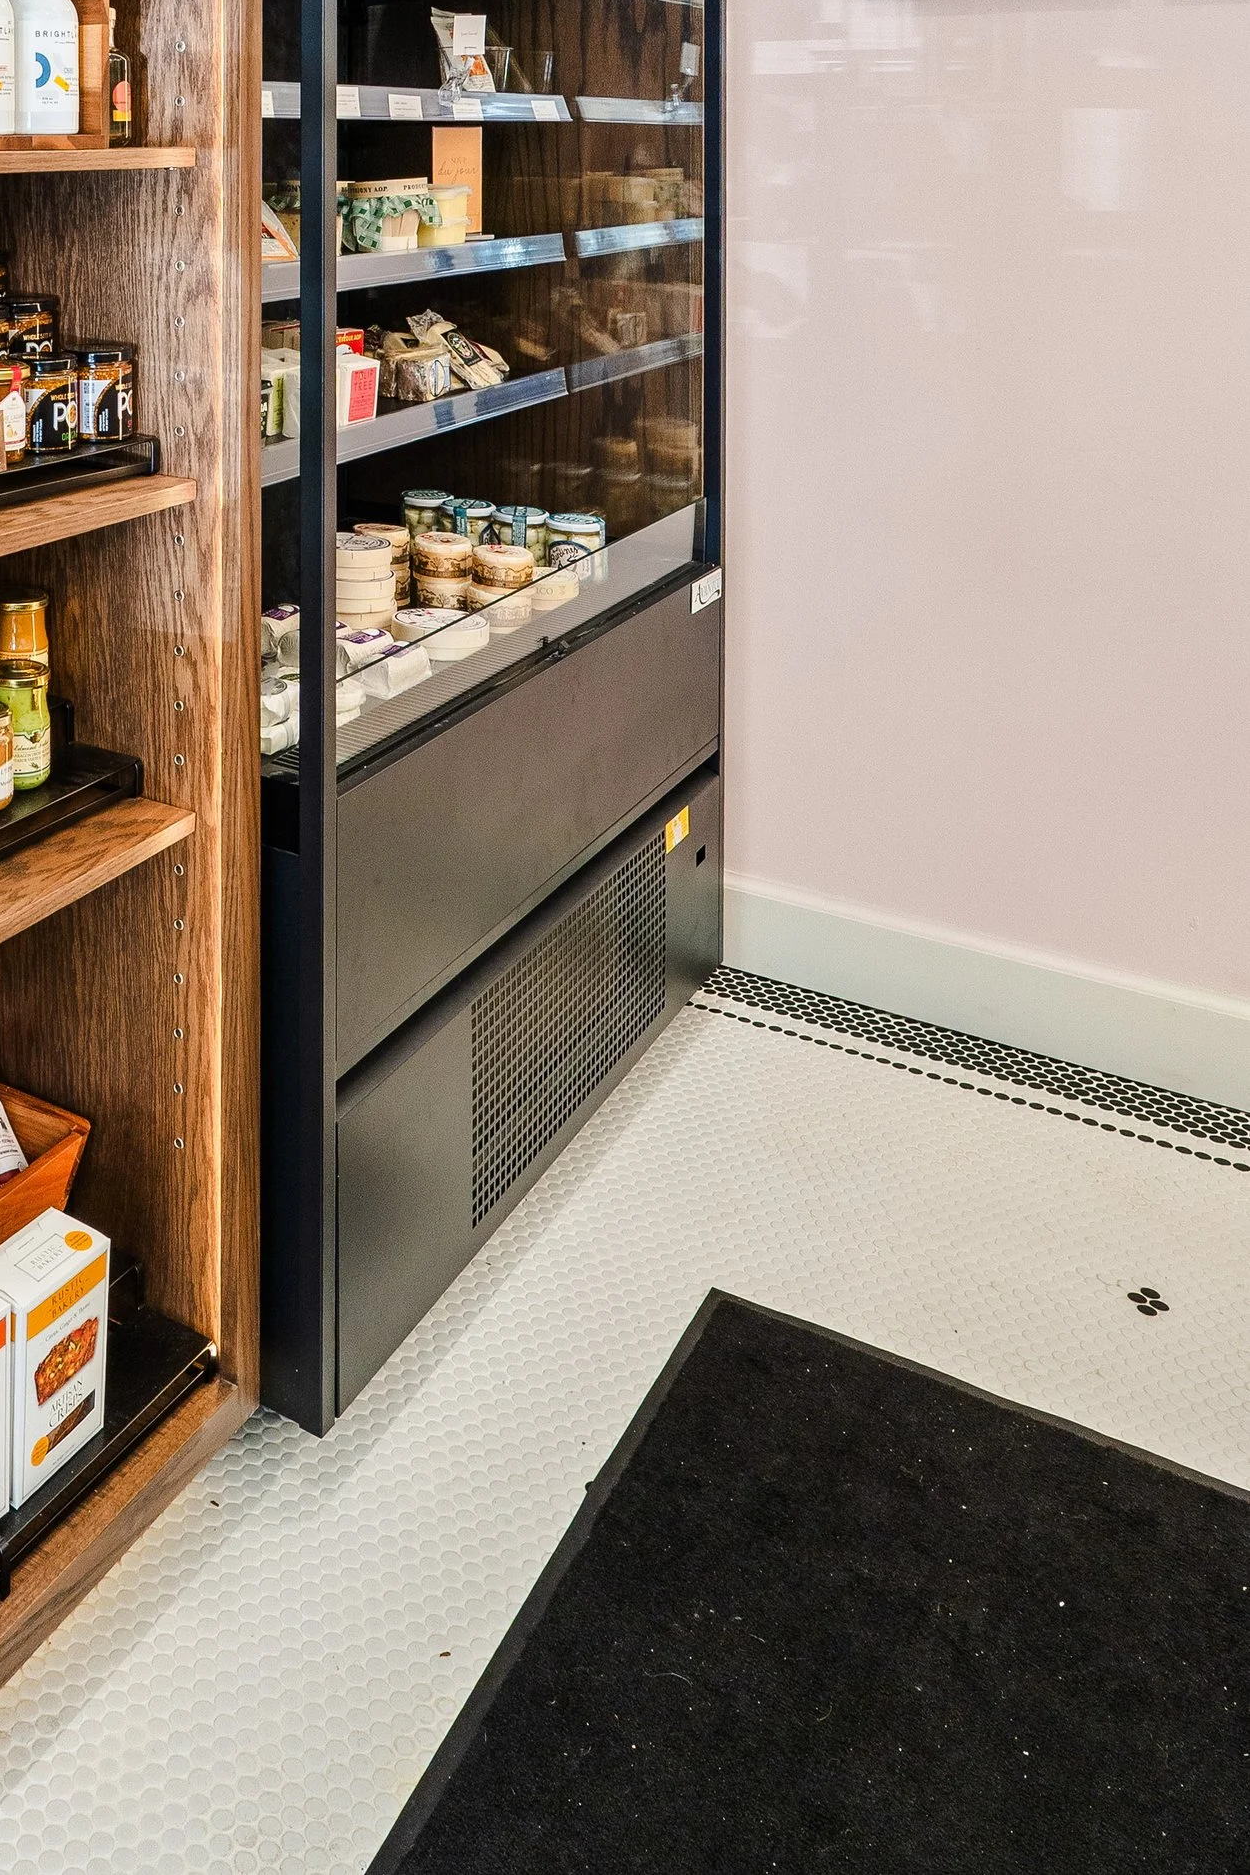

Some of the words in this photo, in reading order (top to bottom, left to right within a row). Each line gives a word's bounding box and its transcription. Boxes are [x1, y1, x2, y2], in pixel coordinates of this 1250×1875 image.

[50, 393, 67, 402] WHOLE
[353, 380, 374, 392] TREE
[29, 1242, 57, 1266] RUSTIC
[36, 1248, 63, 1273] BAKERY
[50, 1273, 85, 1308] RUSTIC
[51, 1285, 87, 1320] BAKERY
[48, 1389, 84, 1429] CRISPS
[49, 1378, 84, 1414] ARTISAN
